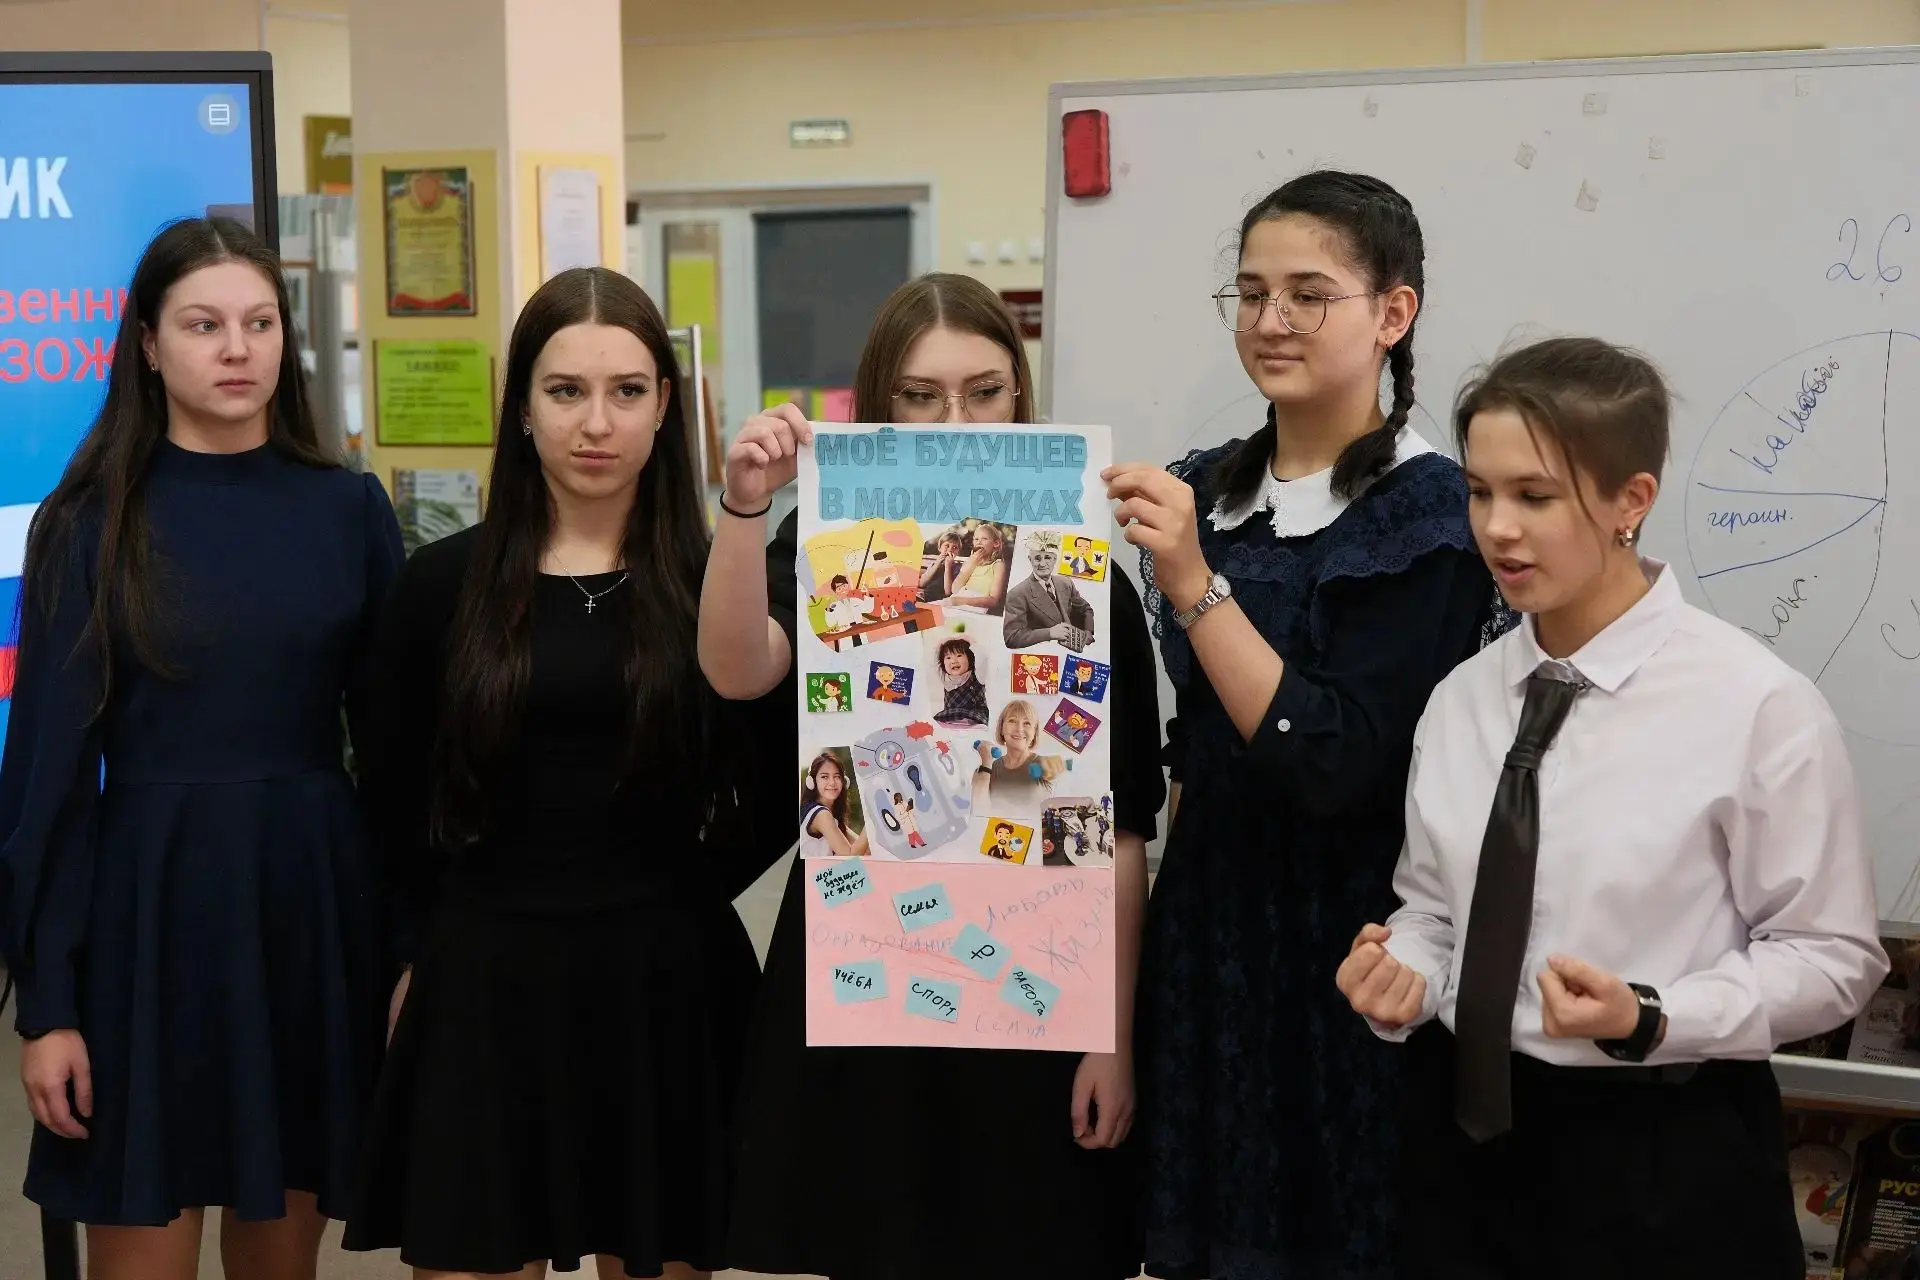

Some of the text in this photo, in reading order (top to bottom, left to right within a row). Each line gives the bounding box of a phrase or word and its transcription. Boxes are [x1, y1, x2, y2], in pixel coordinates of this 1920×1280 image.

[816, 427, 1086, 473] МОЁ БУДУЩЕЕ
[820, 486, 1083, 523] В МОИХ РУКАХ
[911, 982, 957, 1017] СПОРТ
[1878, 1178, 1920, 1197] РУС
